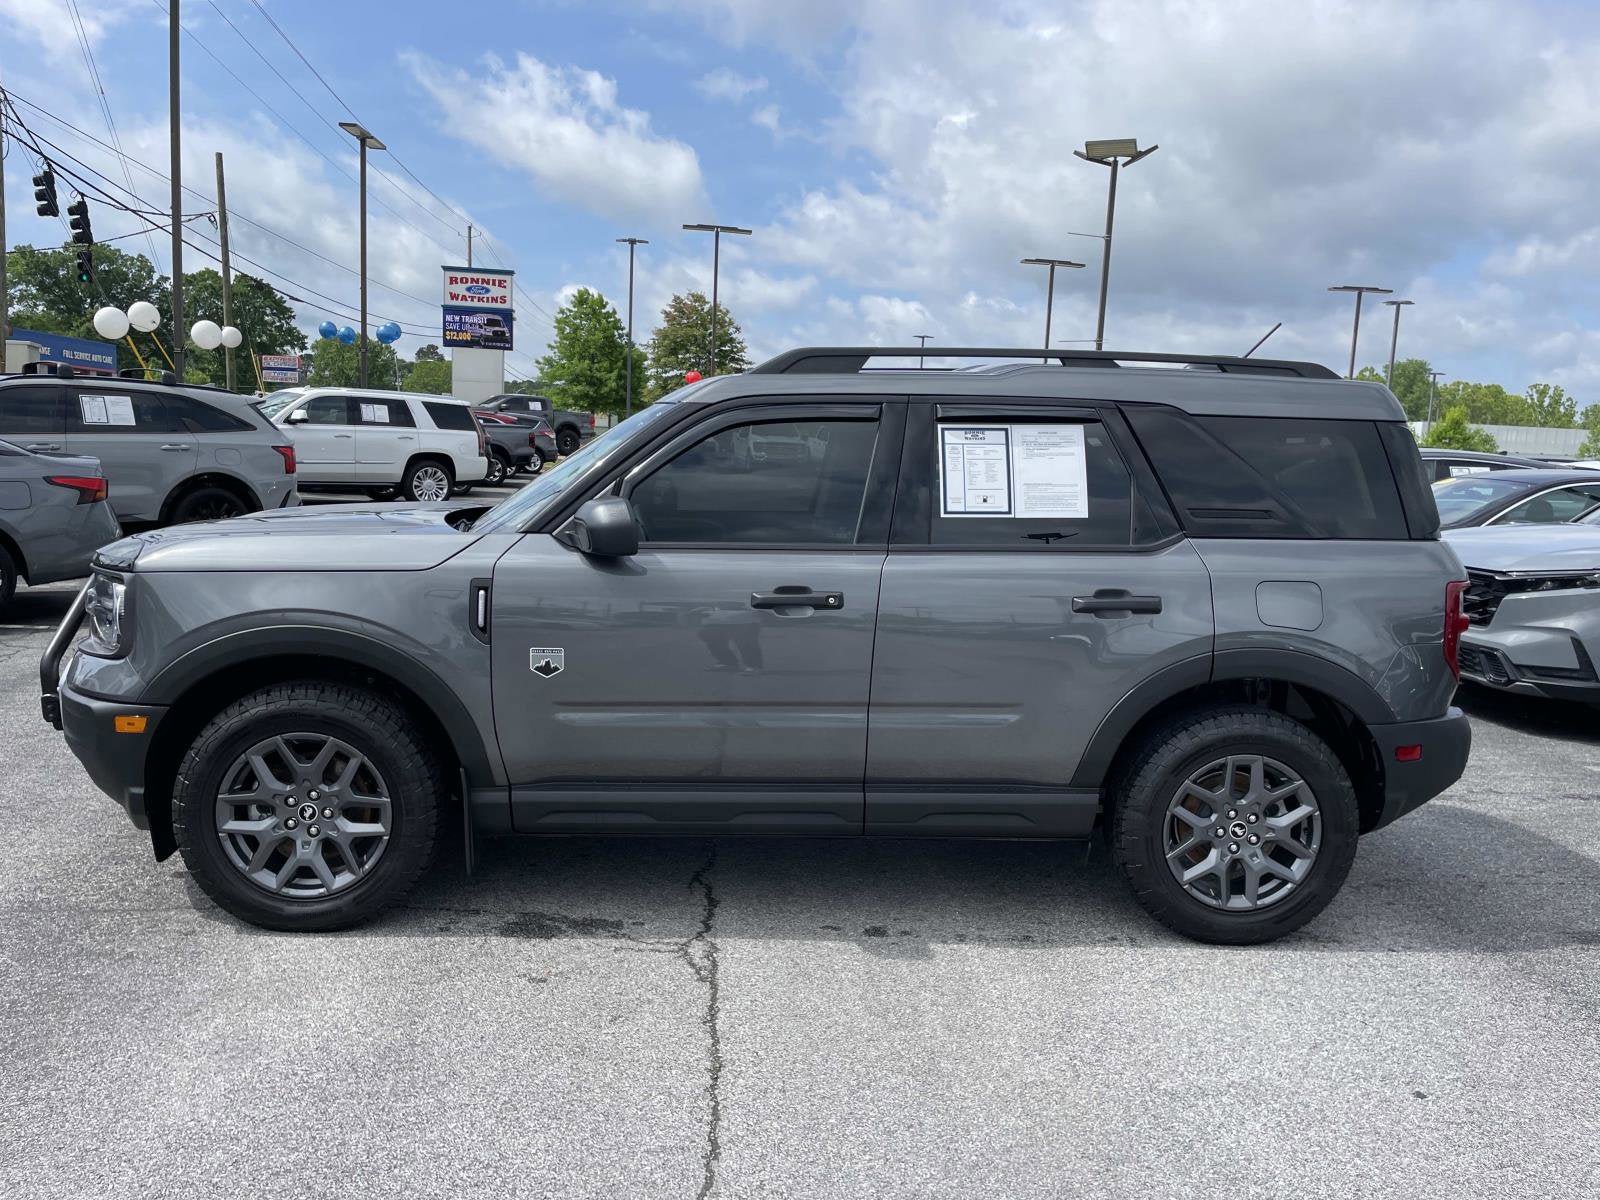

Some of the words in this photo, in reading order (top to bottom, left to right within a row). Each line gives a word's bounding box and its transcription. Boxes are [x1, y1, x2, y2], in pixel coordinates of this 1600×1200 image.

[449, 276, 507, 288] RONNIE
[449, 291, 507, 304] WATKINS
[446, 315, 460, 323] NEW
[462, 315, 488, 324] TRANSIT
[446, 331, 471, 340] $12,000
[63, 349, 73, 358] FULL
[74, 351, 91, 361] SERVICE
[91, 354, 102, 363] AUTO
[103, 355, 113, 364] CARE
